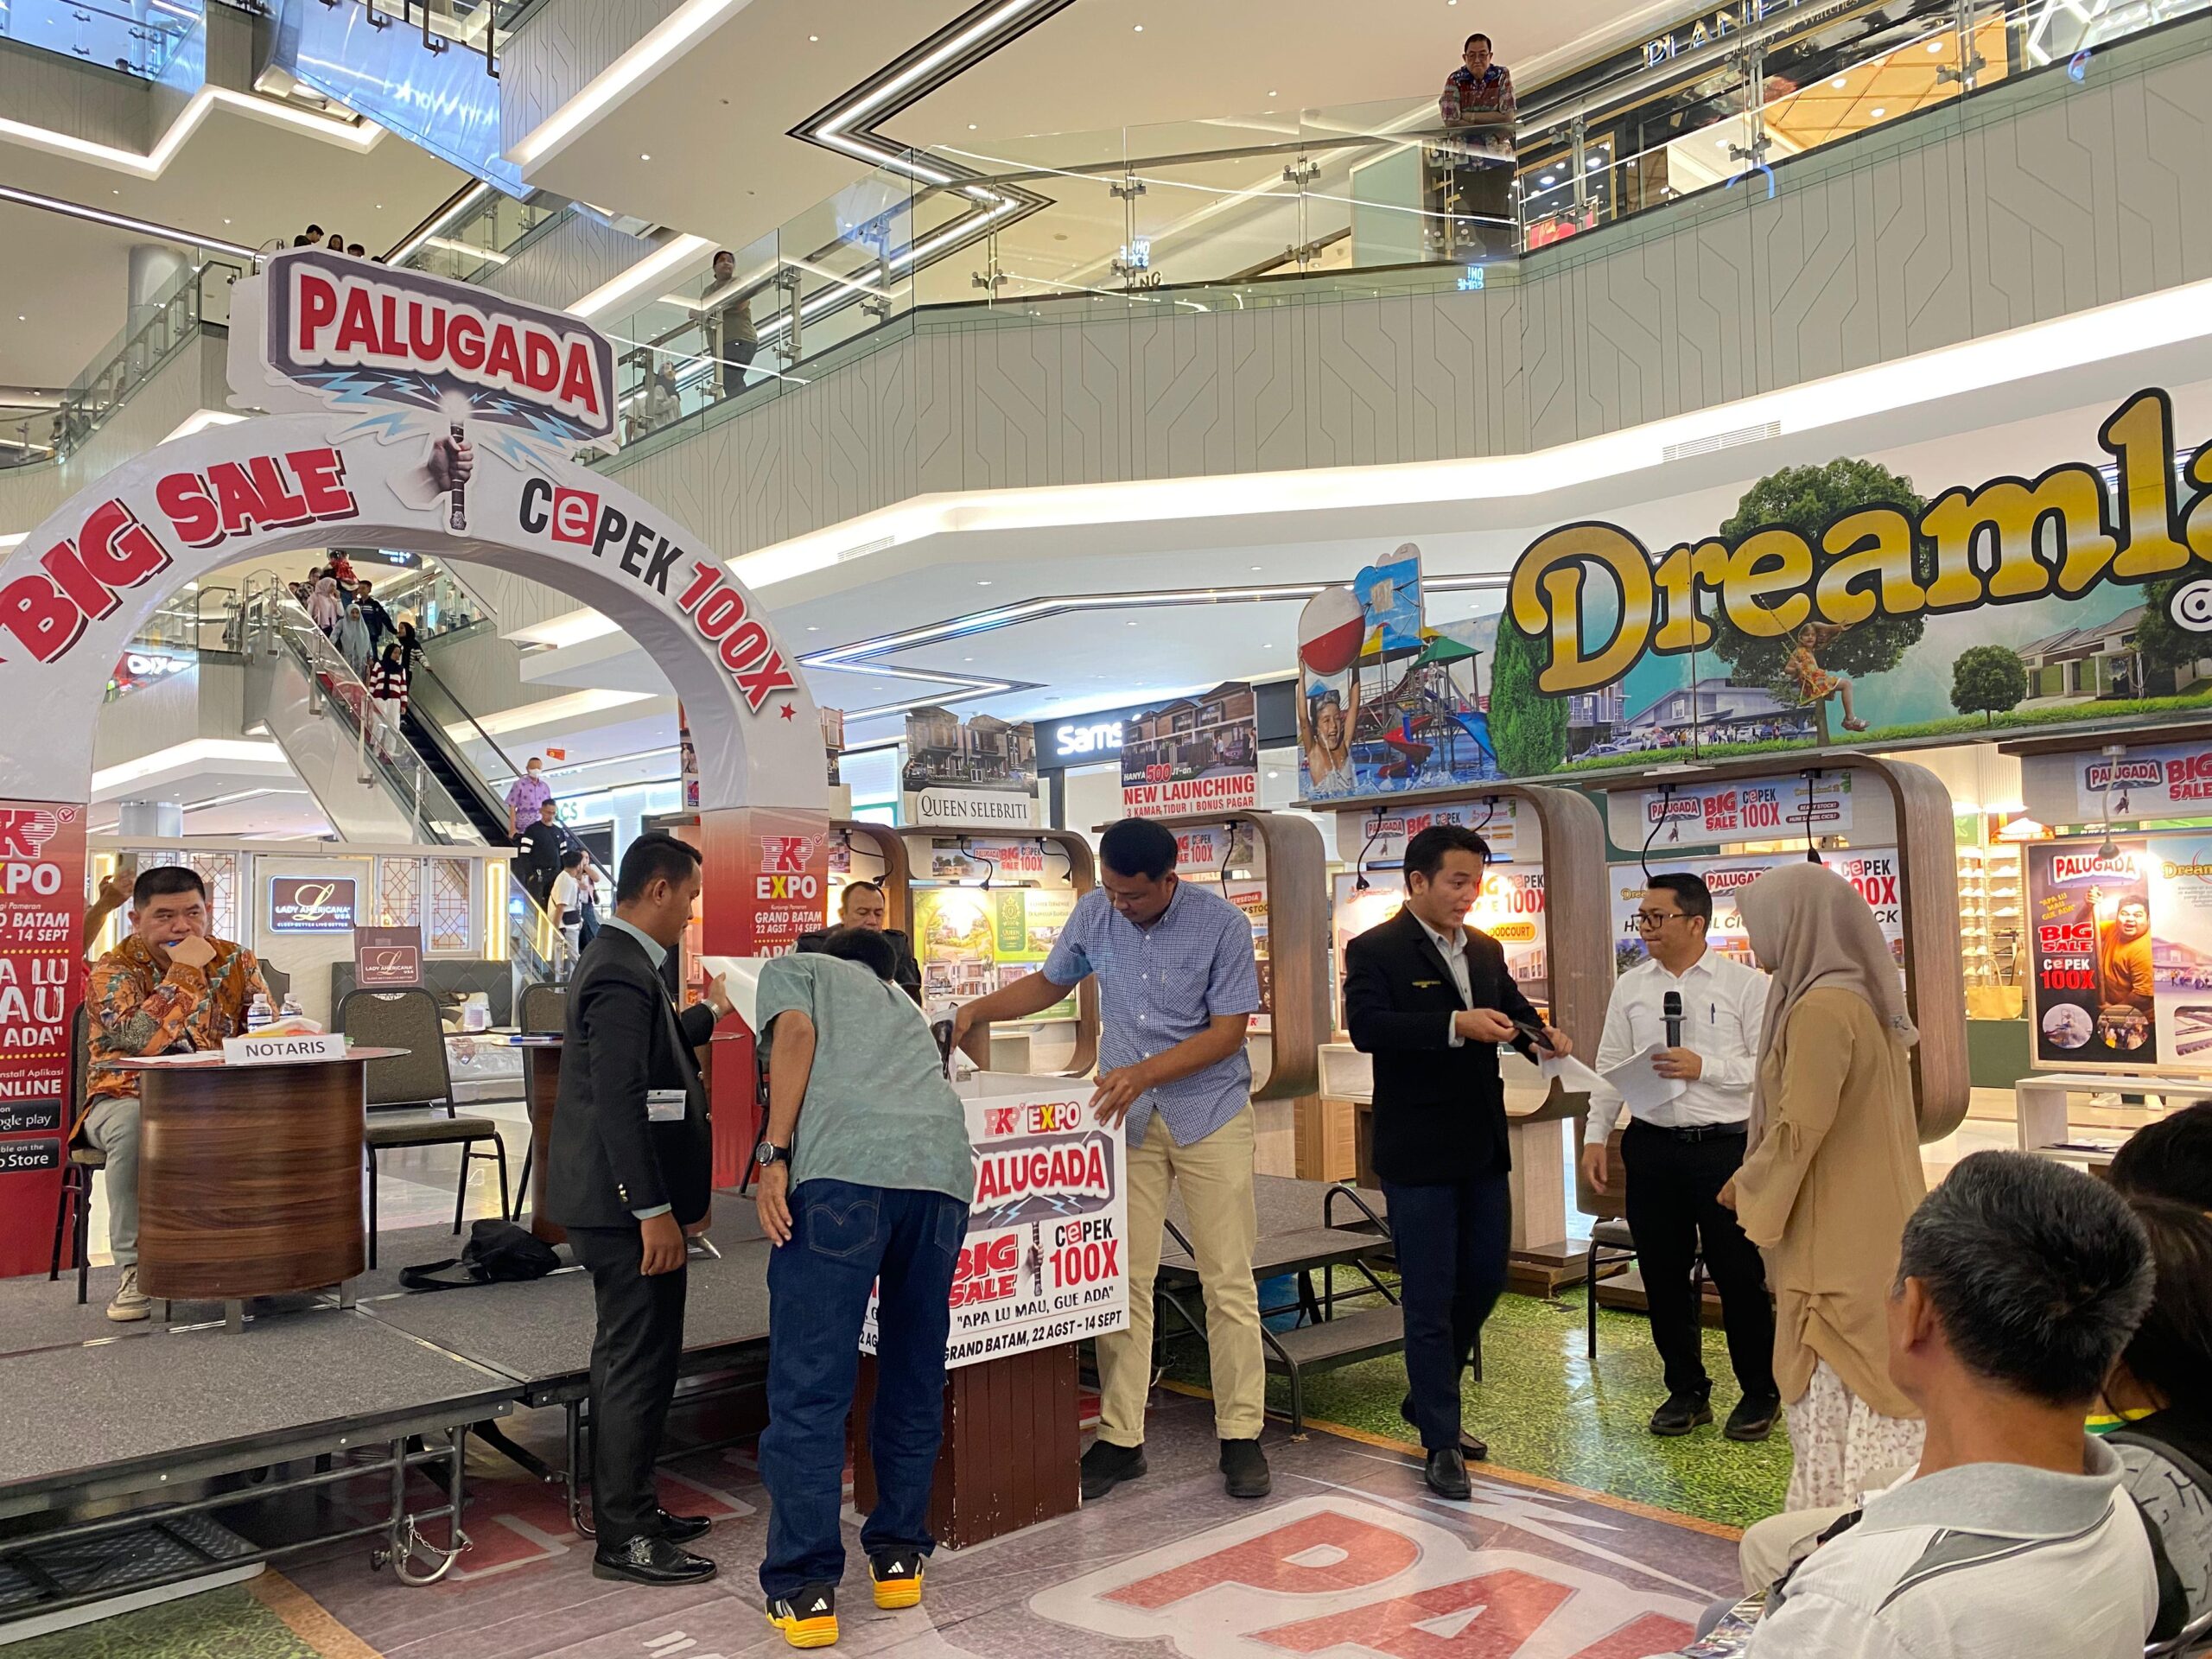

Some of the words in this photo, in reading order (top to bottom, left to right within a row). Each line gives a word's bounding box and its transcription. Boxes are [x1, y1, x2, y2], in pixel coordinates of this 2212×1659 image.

[300, 274, 601, 416] PALUGADA
[3, 497, 174, 664] BIG
[156, 447, 360, 550] SALE
[676, 561, 798, 715] 100X
[1123, 771, 1146, 781] HANYA
[1146, 763, 1172, 784] 500
[2090, 763, 2158, 787] PALUGADA
[2165, 752, 2212, 784] BIG
[1124, 786, 1158, 804] NEW
[1162, 774, 1255, 802] LAUNCHING
[2169, 783, 2212, 802] SALE
[921, 795, 967, 817] QUEEN
[970, 802, 1027, 819] SELEBRITI
[1127, 808, 1132, 817] 3
[1134, 806, 1161, 817] KAMAR
[1163, 802, 1186, 814] TIDUR
[1196, 798, 1223, 810] BONUS
[1226, 796, 1254, 808] PAGAR
[1651, 799, 1699, 819] PALUGADA
[1703, 791, 1737, 817] BIG
[1706, 815, 1737, 831] SALE
[1739, 802, 1781, 829] 100X
[1368, 820, 1403, 836] PALUGADA
[1407, 815, 1431, 835] BIG
[1177, 835, 1189, 851] IG
[1000, 847, 1020, 861] BIG
[1191, 844, 1213, 863] 100X
[1001, 861, 1020, 871] SALE
[1020, 856, 1043, 871] 100X
[2056, 854, 2137, 879] PALUGADA
[756, 875, 817, 899] EXPO
[2058, 892, 2068, 900] LU
[8, 902, 41, 911] Pameran
[276, 906, 298, 914] LADY
[299, 905, 351, 914] AMERICANA
[2047, 900, 2065, 911] MAU
[13, 912, 70, 928] BATAM
[754, 912, 790, 923] GRAND
[791, 911, 822, 922] BATAM
[1874, 910, 1898, 923] CK
[2042, 912, 2056, 920] GUE
[18, 929, 33, 942] 14
[36, 929, 69, 942] SEPT
[755, 925, 766, 934] 22
[766, 924, 787, 934] AGST
[794, 925, 804, 934] 14
[804, 923, 822, 932] SEPT
[2038, 922, 2094, 942] BIG
[2042, 941, 2094, 953] SALE
[31, 957, 68, 984] LU
[2040, 969, 2096, 989] 100X
[3, 1027, 62, 1047] ADA"
[245, 1039, 326, 1058] NOTARIS
[28, 1068, 63, 1077] Aplikasi
[26, 1114, 52, 1128] play
[1027, 1100, 1081, 1135] EXPO
[9, 1153, 49, 1167] Store
[971, 1146, 1107, 1204] ALUGADA
[952, 1233, 1019, 1283] BIG
[949, 1273, 1019, 1309] SALE
[1049, 1238, 1120, 1288] 100X
[957, 1312, 990, 1329] "APA
[995, 1306, 1010, 1322] LU
[1015, 1300, 1050, 1318] MAU,
[1054, 1293, 1079, 1310] GUE
[1084, 1286, 1114, 1304] ADA"
[985, 1330, 1030, 1353] BATAM,
[1032, 1325, 1046, 1342] 22
[1046, 1319, 1076, 1340] AGST
[1085, 1316, 1096, 1332] 14
[1097, 1310, 1123, 1329] SEPT
